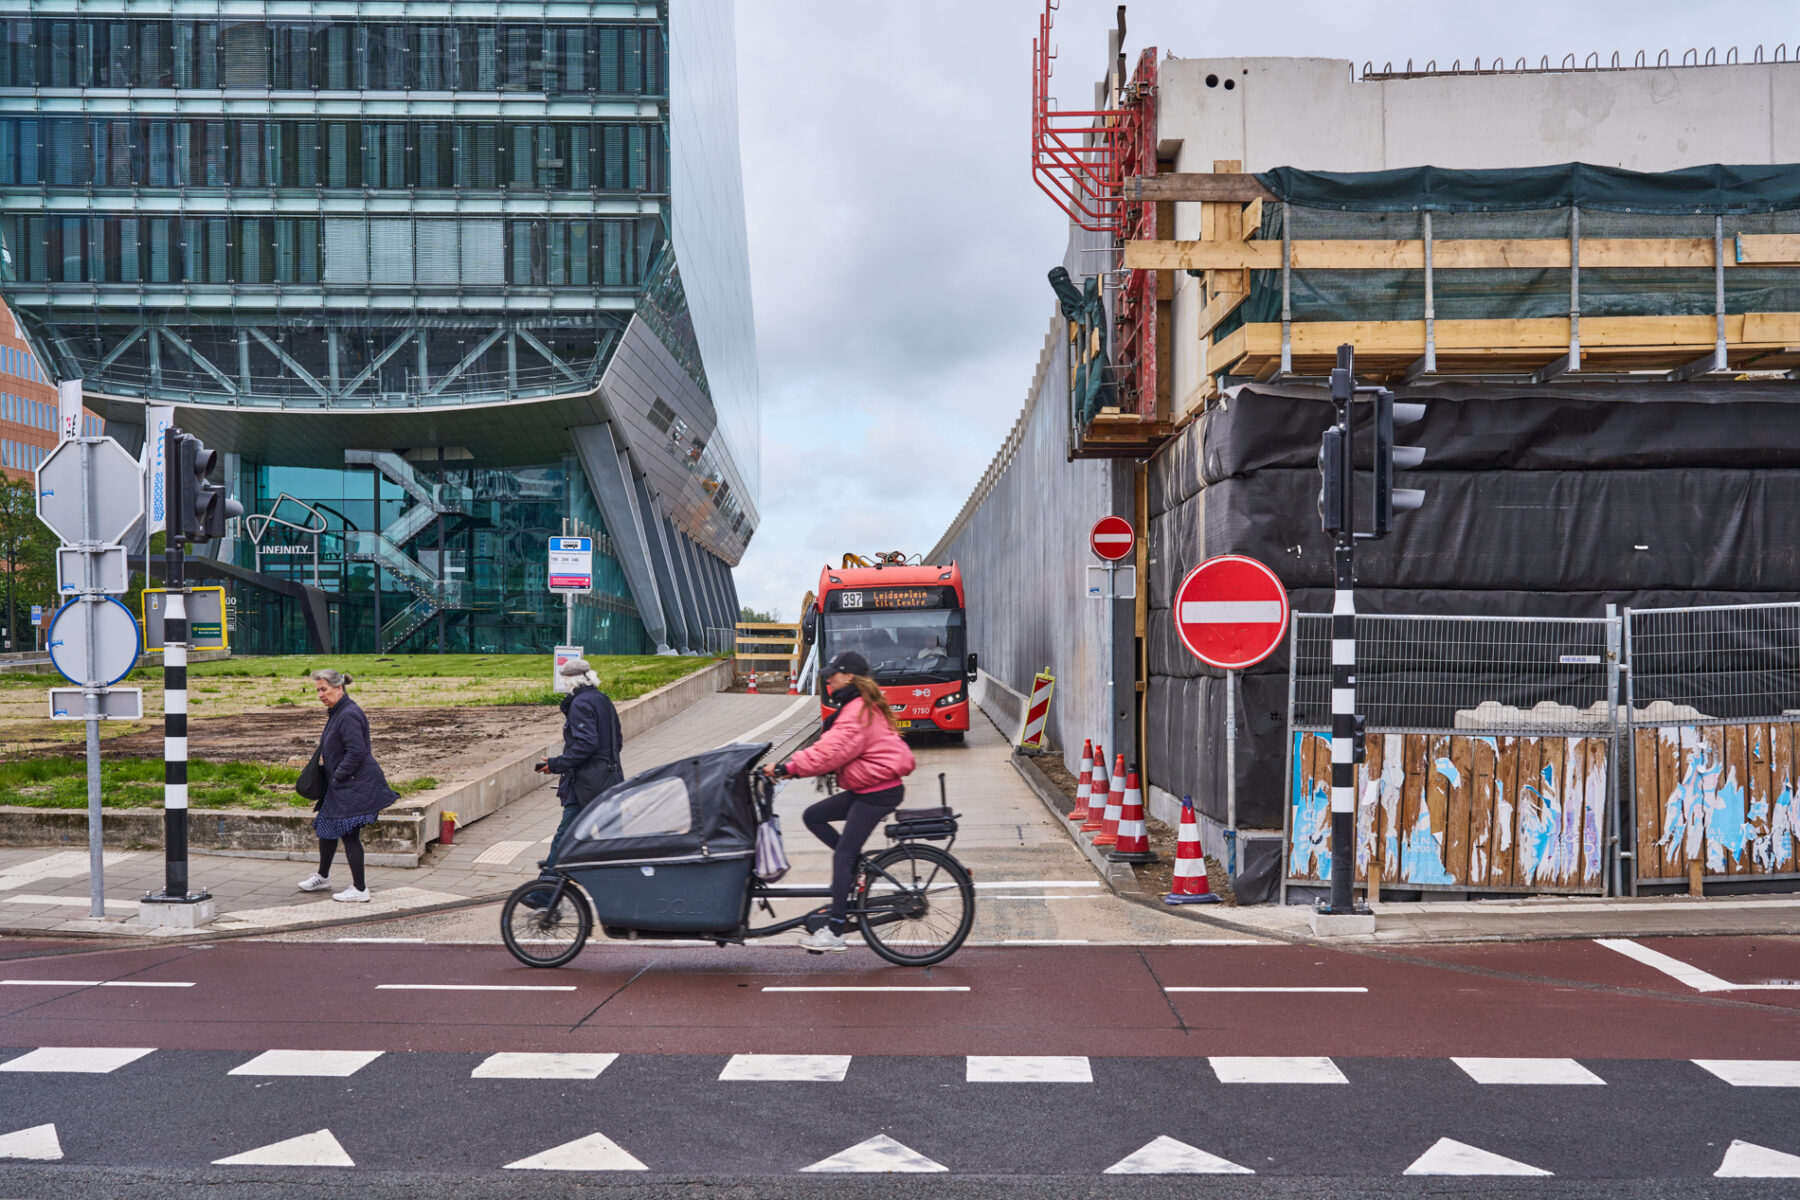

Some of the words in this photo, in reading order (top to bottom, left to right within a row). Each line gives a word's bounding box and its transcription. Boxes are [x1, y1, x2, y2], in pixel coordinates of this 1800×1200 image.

[262, 546, 309, 554] INFINITY
[843, 593, 863, 607] 397
[873, 590, 928, 600] Leidseplein
[875, 599, 894, 607] City
[897, 599, 926, 607] Centre
[657, 897, 723, 915] DOLLY
